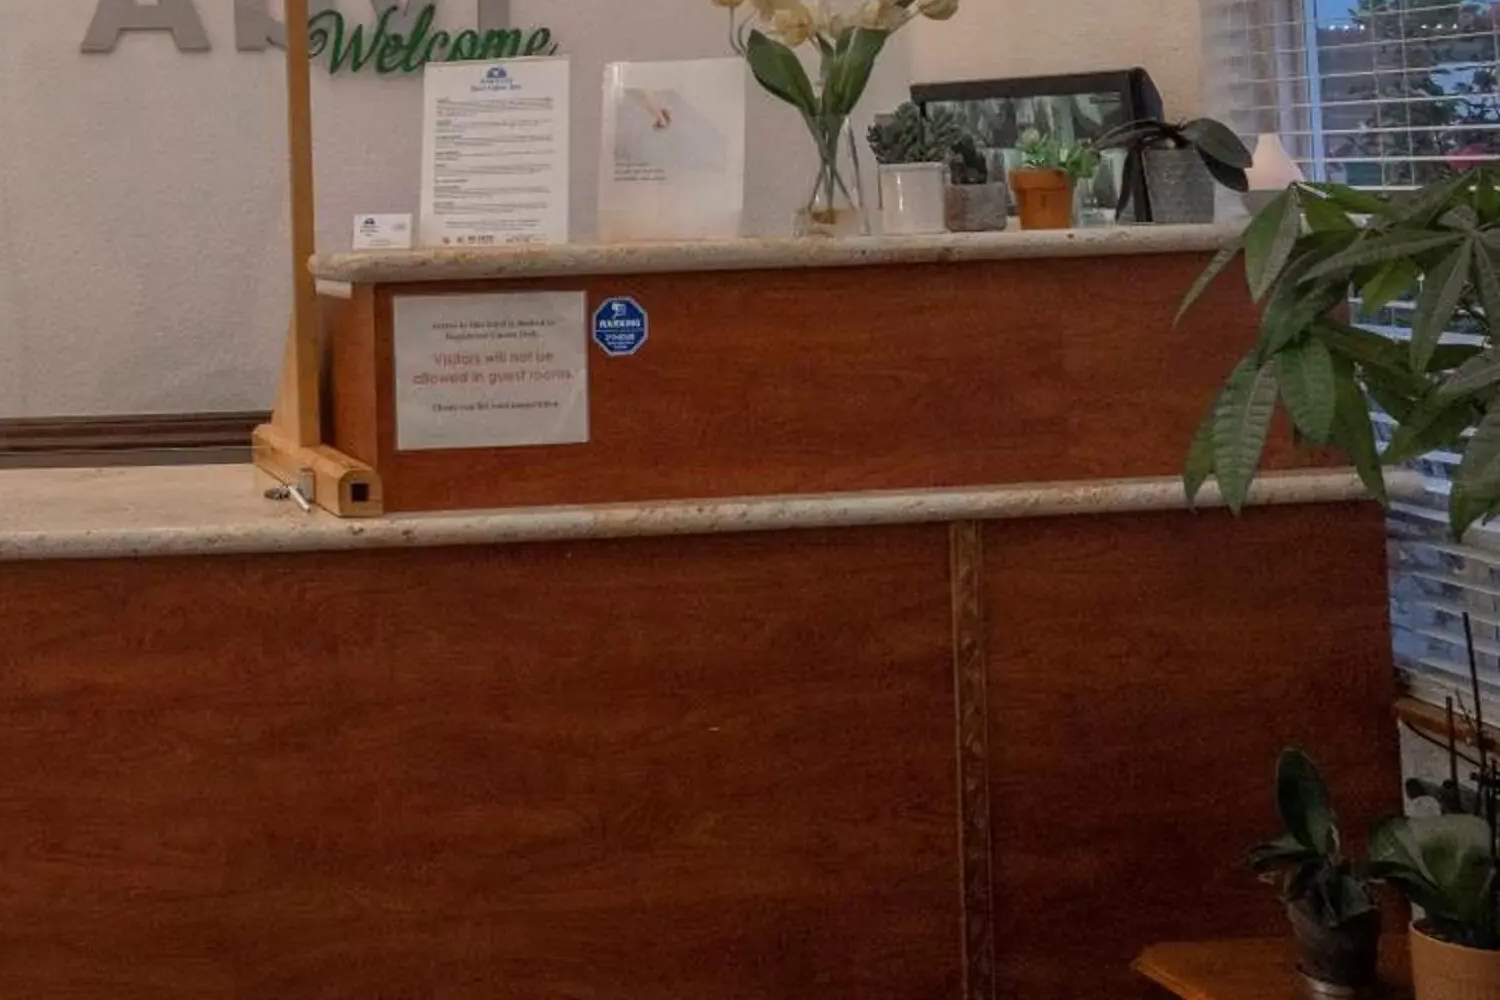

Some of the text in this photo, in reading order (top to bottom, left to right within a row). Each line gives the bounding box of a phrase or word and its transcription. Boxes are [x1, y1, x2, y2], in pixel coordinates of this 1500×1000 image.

[300, 4, 558, 75] Welcome
[434, 350, 554, 365] Visitors will not be
[412, 372, 468, 385] allowed
[472, 371, 484, 383] in
[488, 370, 526, 385] guest
